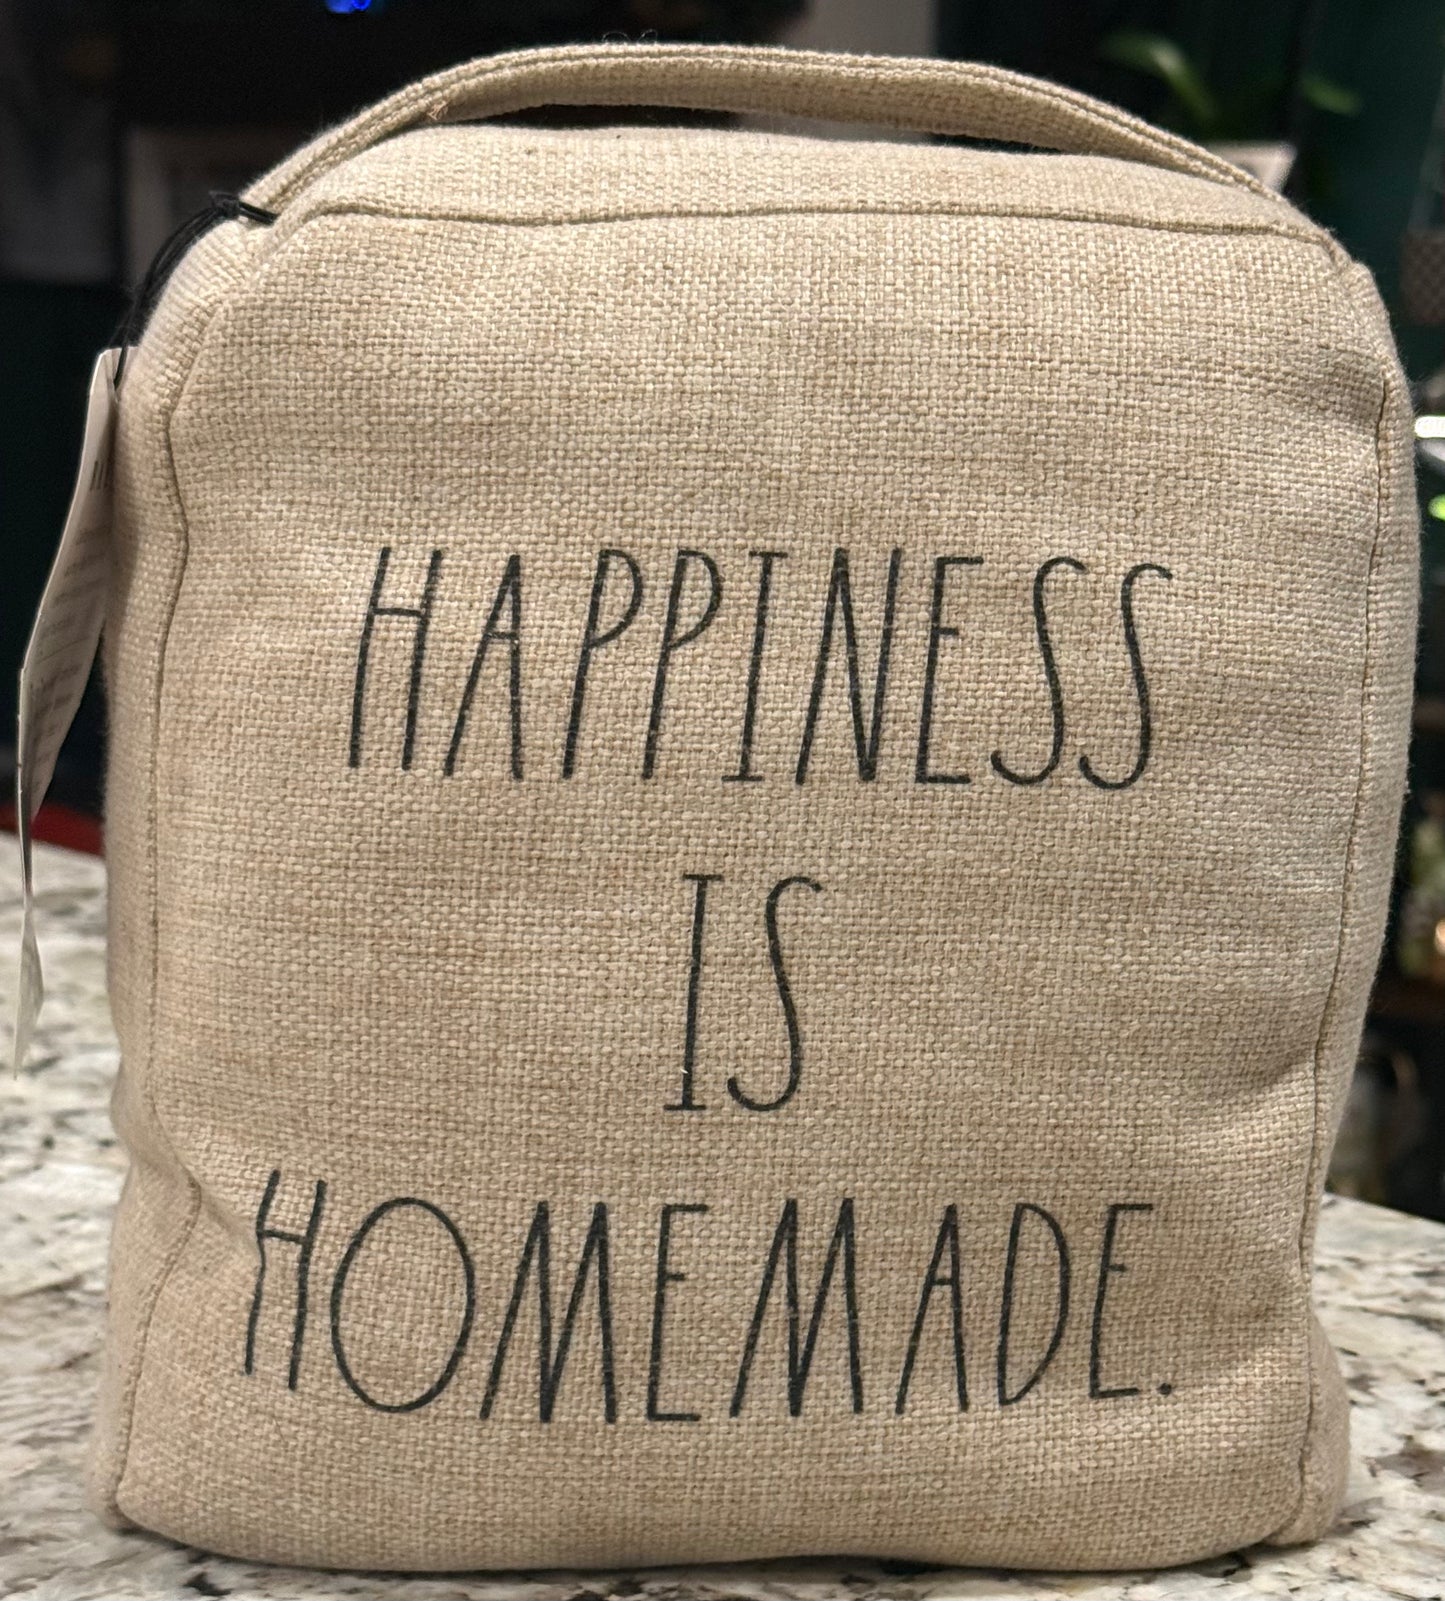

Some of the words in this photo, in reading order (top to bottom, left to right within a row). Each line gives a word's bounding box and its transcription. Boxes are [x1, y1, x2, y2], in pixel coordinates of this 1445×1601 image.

[349, 546, 1172, 790] HAPPINESS
[664, 873, 822, 1113] IS
[245, 1169, 1174, 1424] HOMEMADE.
